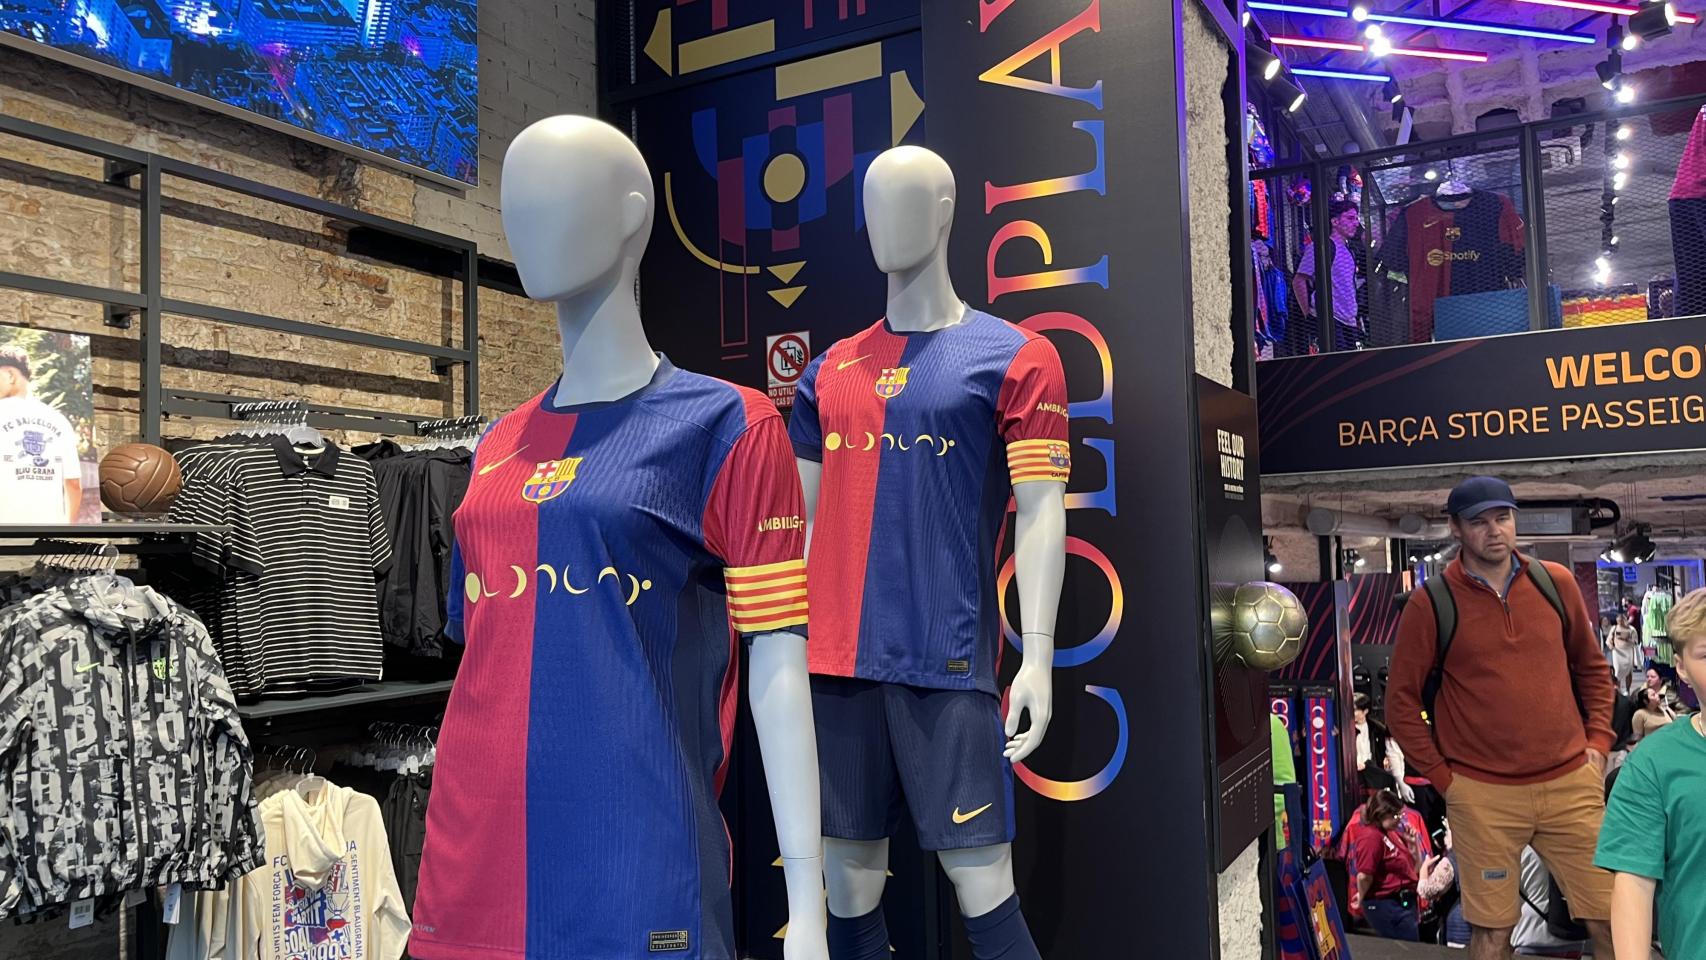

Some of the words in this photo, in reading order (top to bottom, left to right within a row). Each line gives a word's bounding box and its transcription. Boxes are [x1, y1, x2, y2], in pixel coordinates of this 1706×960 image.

[1444, 249, 1480, 261] Spotify
[1545, 345, 1706, 389] WELCO
[768, 388, 778, 397] NO
[978, 0, 1129, 802] COLDPLA
[3, 422, 14, 433] FC
[1338, 415, 1439, 447] BARÇA
[1448, 406, 1550, 440] STORE
[1561, 395, 1705, 432] PASSEIG
[1217, 428, 1232, 455] FEEL
[1231, 433, 1245, 458] OUR
[1220, 454, 1244, 481] HISTORY
[272, 872, 282, 902] FORÇA
[350, 854, 360, 903] SENTIMENT
[272, 903, 281, 923] FEM
[353, 904, 363, 958] BLAUGRANA
